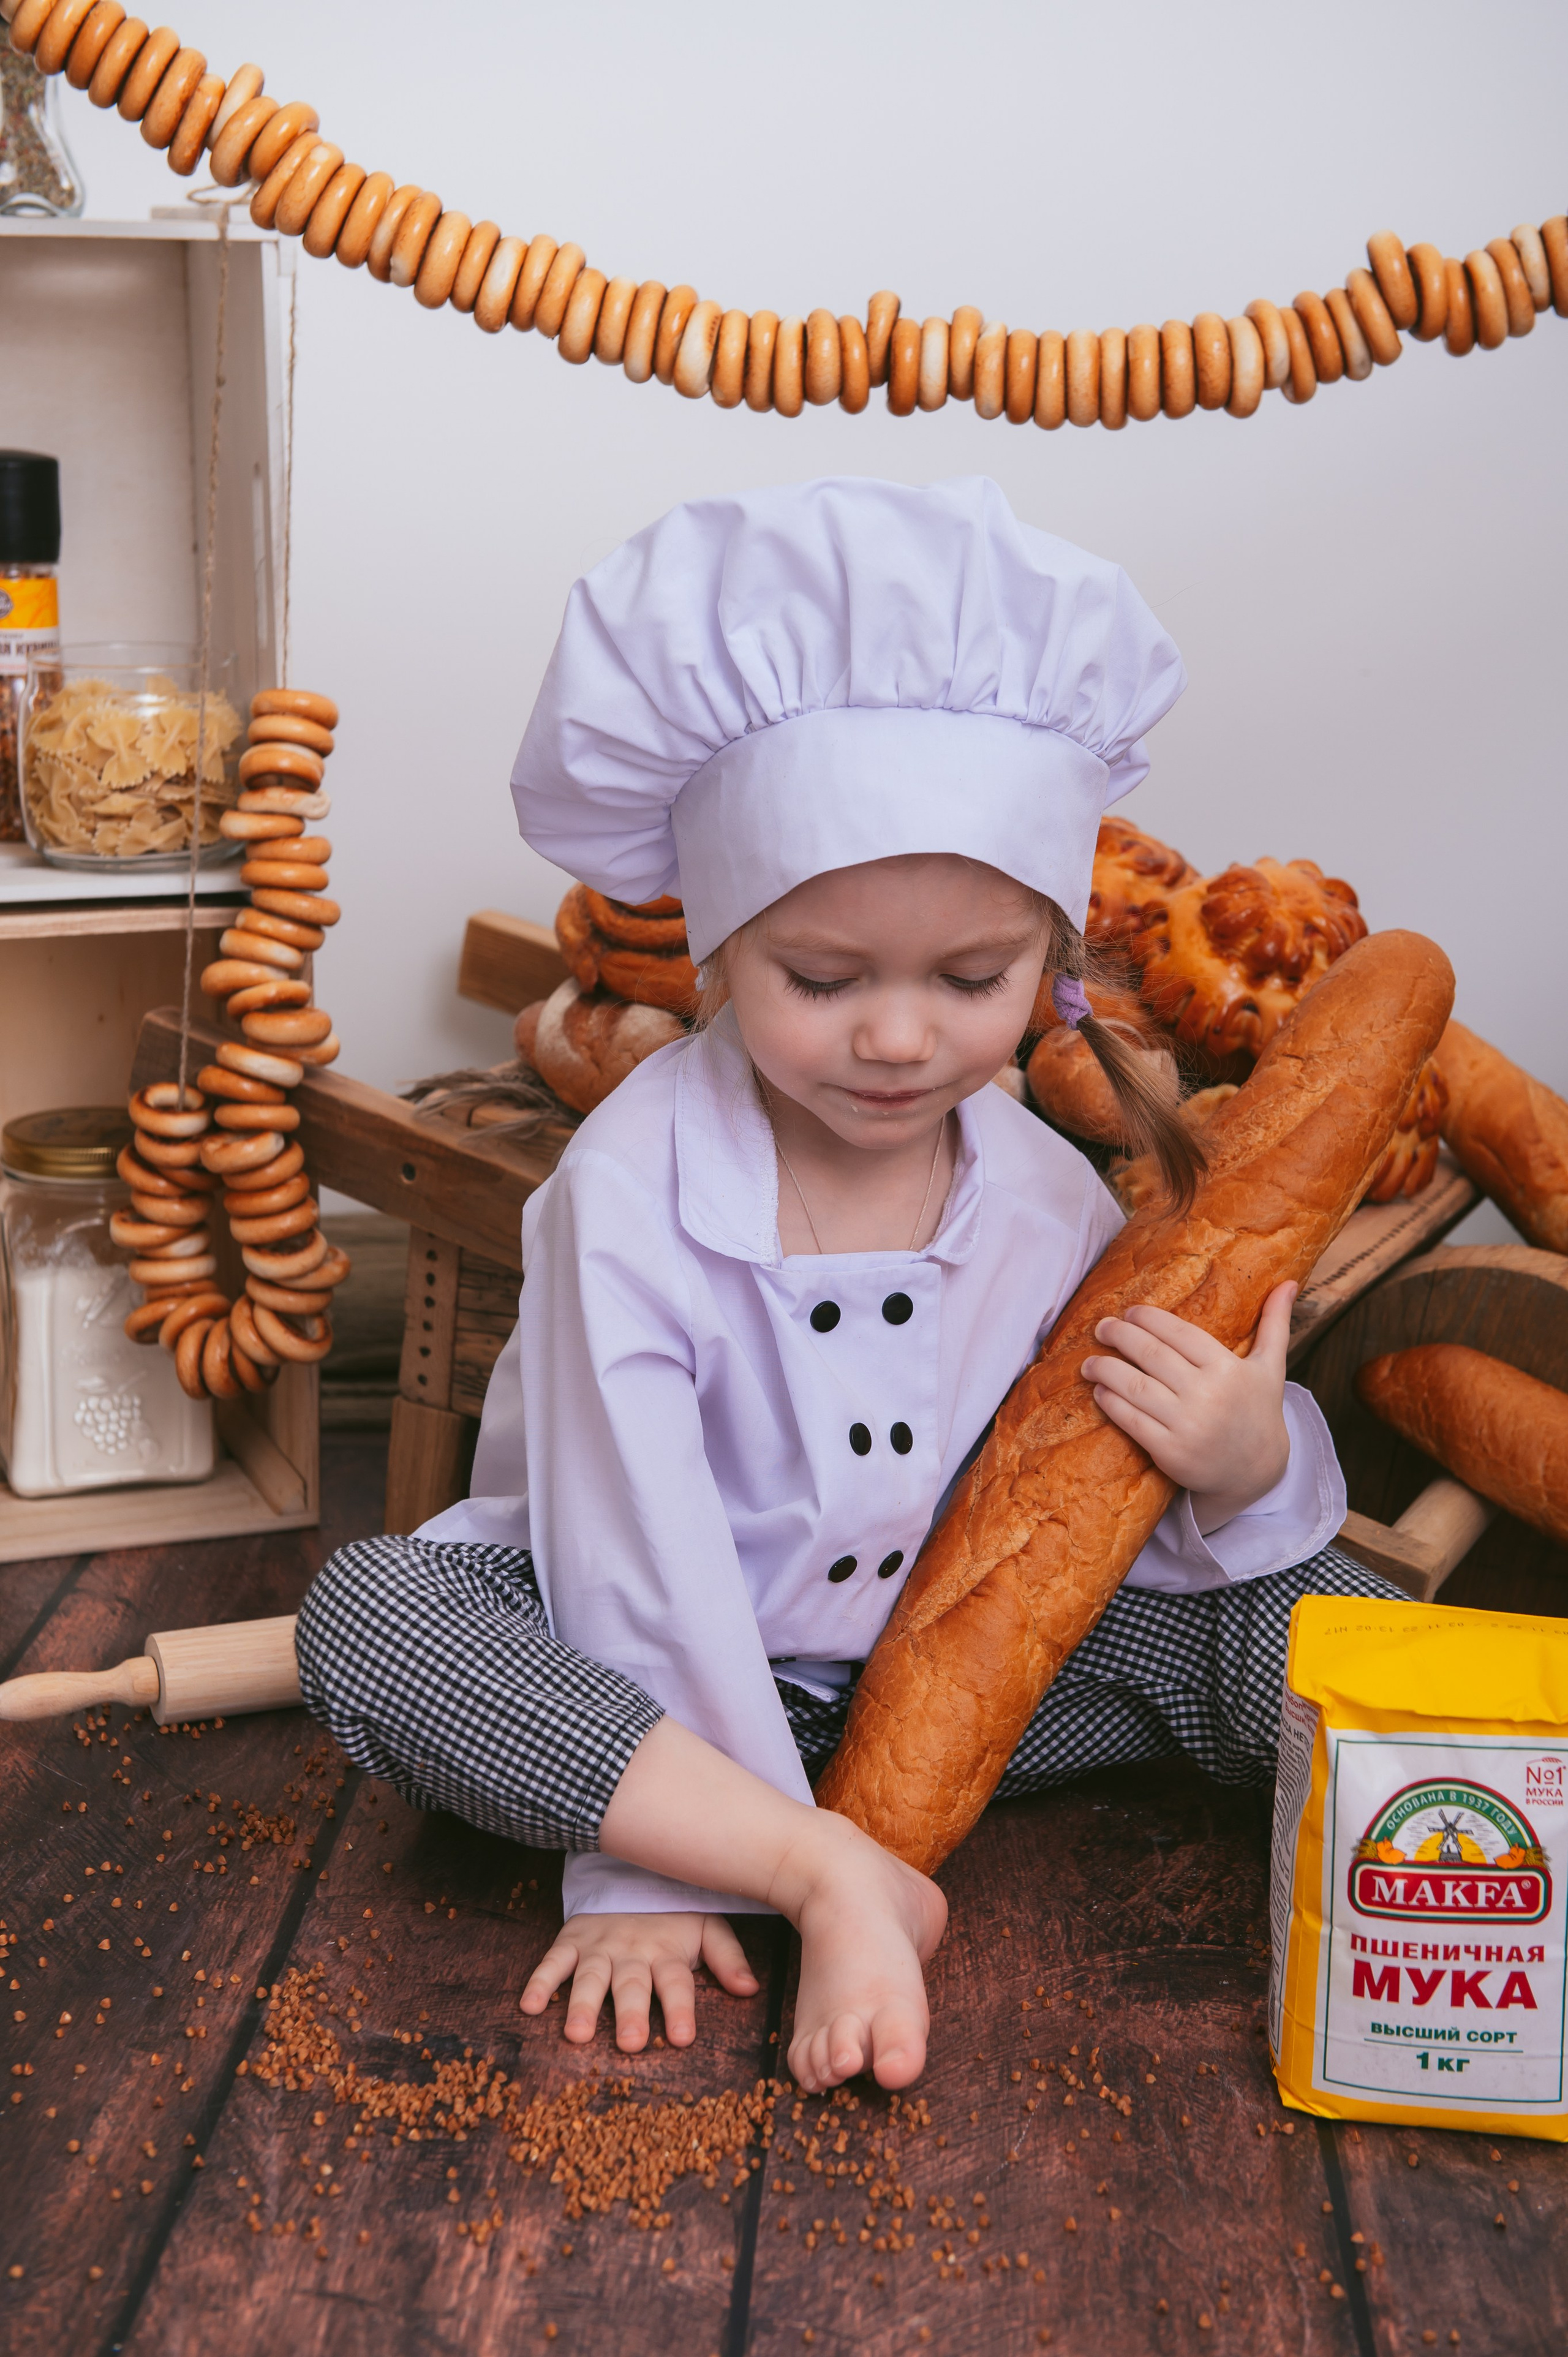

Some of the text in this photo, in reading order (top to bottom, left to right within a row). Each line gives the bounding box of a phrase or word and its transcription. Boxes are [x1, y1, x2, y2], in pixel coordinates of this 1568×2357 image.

[1526, 1787, 1562, 1798] МУКА
[1386, 1790, 1518, 1835] ОСНОВАНА В 1937 ГОДУ
[1350, 1932, 1545, 1964] ПШЕНИЧНАЯ
[1352, 1958, 1539, 2010] МУКА
[1370, 2021, 1518, 2044] ВЫСШИЙ СОРТ
[1415, 2051, 1430, 2070] 1
